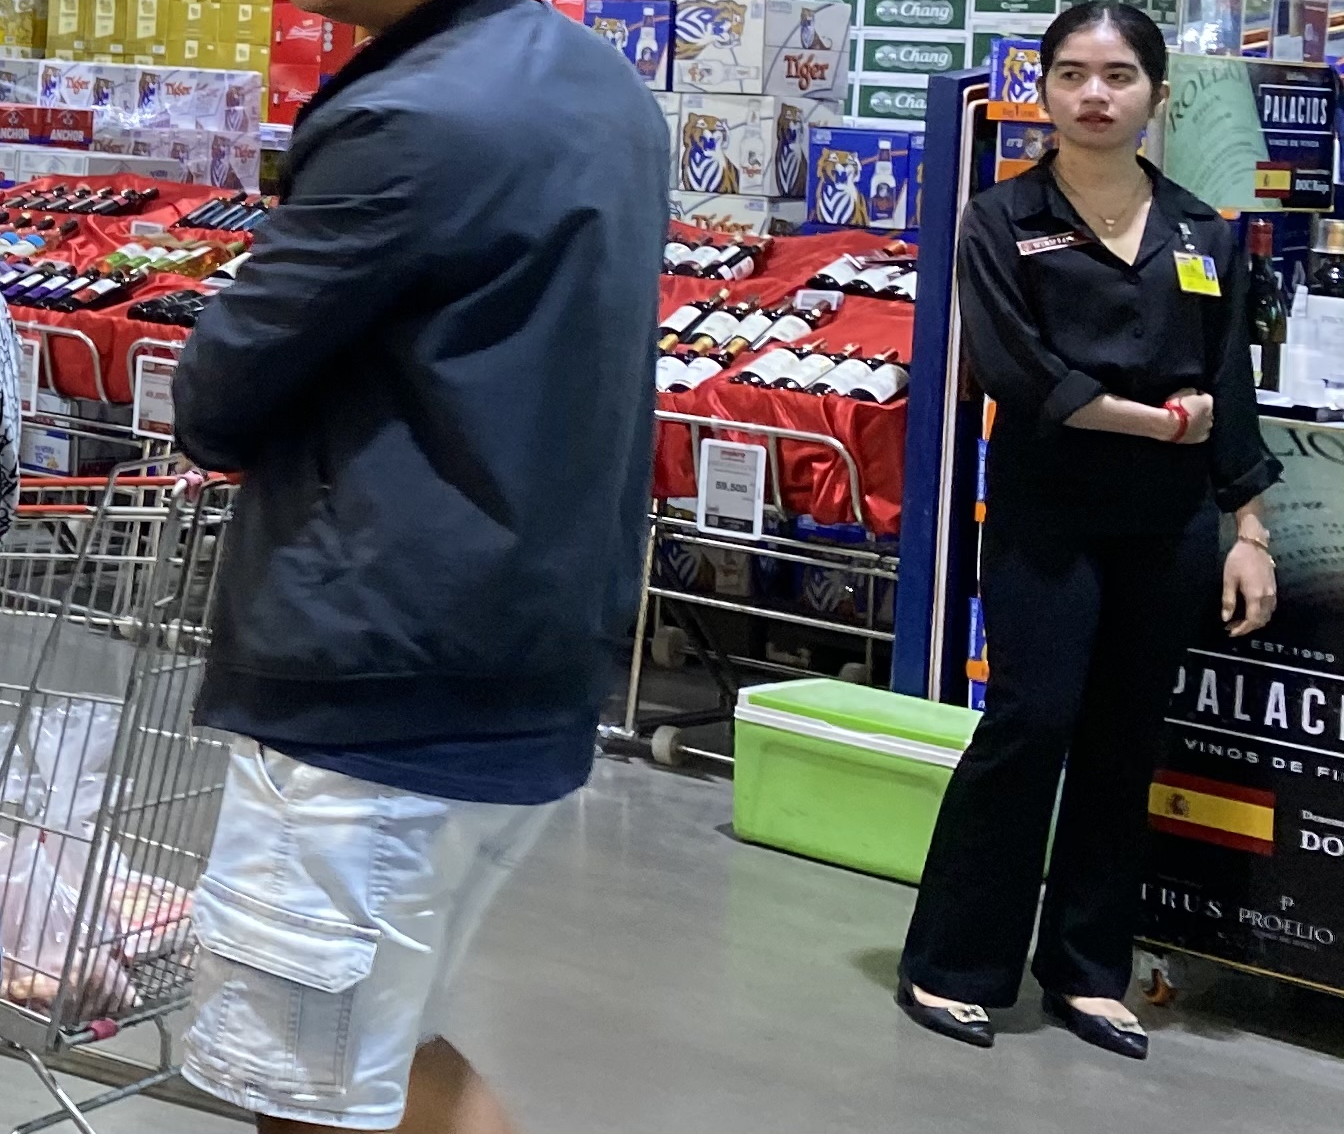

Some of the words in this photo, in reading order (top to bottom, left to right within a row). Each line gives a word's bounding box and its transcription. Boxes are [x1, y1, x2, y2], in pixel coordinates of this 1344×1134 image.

[901, 2, 949, 21] Chang
[899, 47, 948, 66] Chang
[784, 54, 830, 90] Tiger
[65, 76, 90, 98] Tiger
[165, 81, 192, 98] Tiger
[895, 93, 927, 109] Cha
[1264, 95, 1328, 125] PALACIOS
[50, 129, 84, 143] ANCHOR
[1184, 738, 1259, 764] VINOS
[1272, 756, 1303, 774] DE
[1239, 907, 1335, 945] PROELIO
